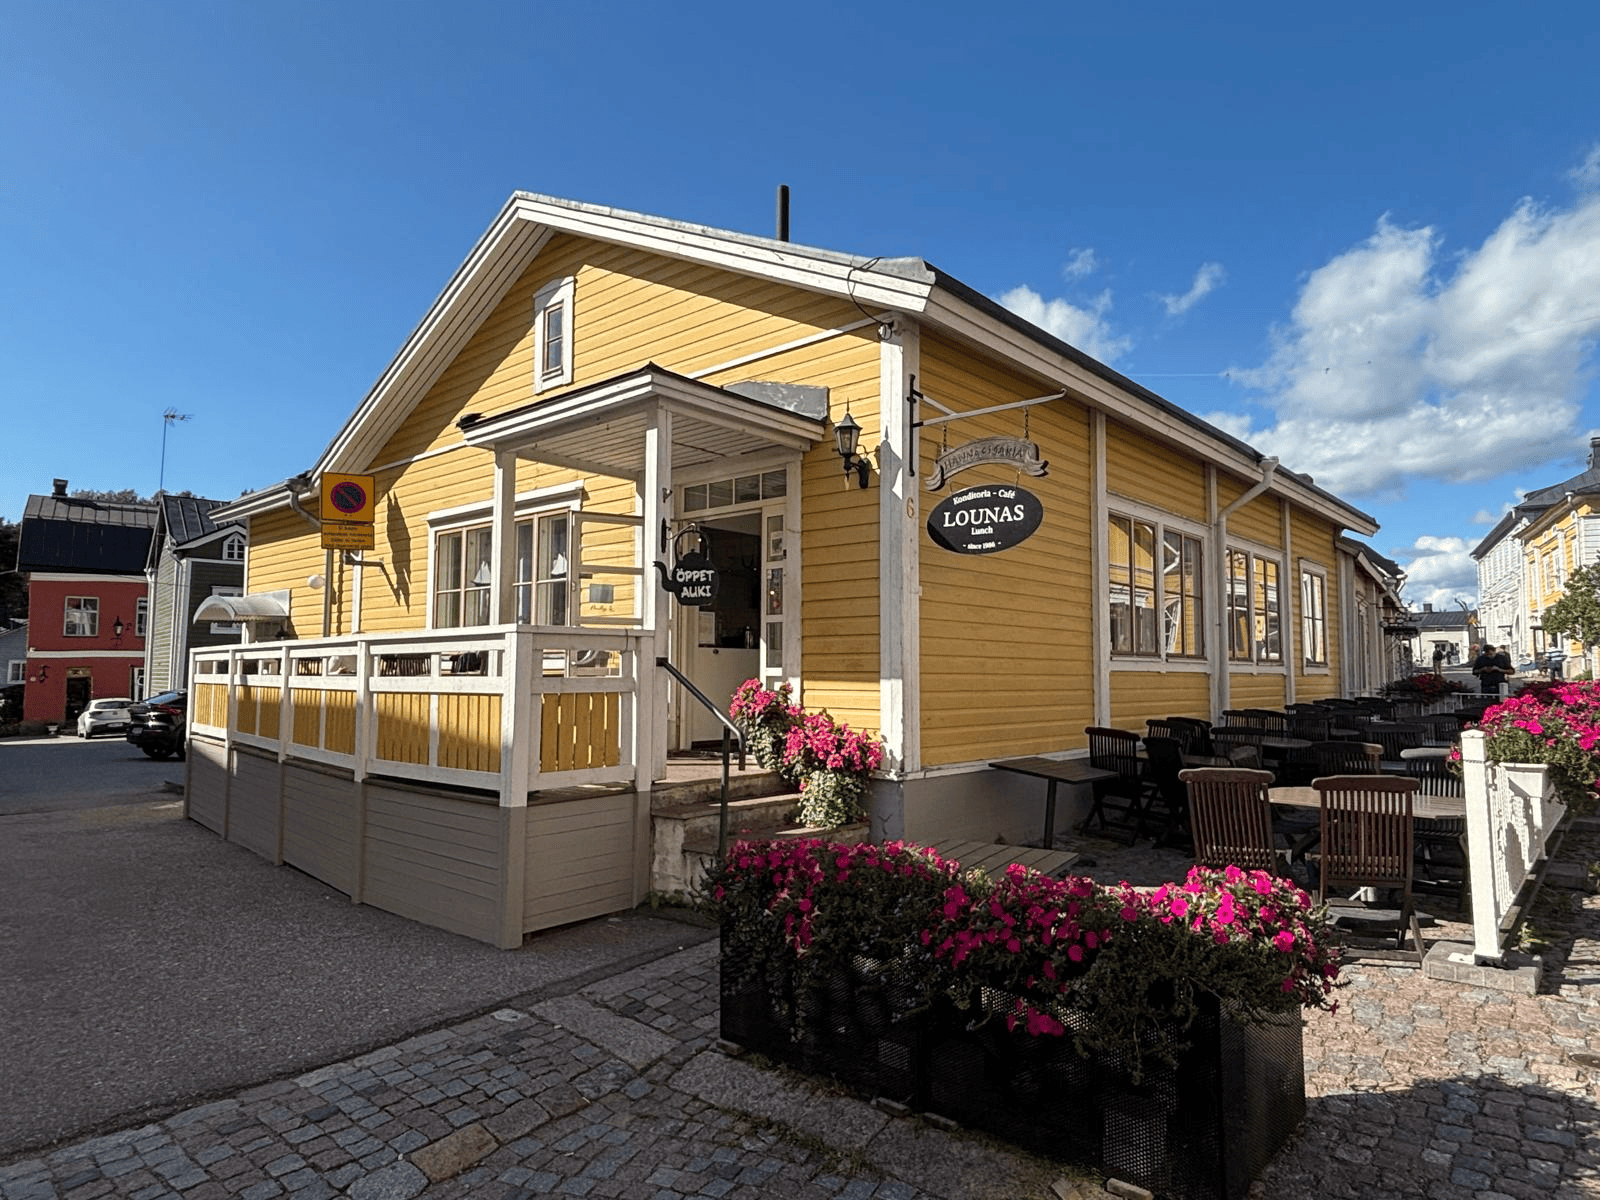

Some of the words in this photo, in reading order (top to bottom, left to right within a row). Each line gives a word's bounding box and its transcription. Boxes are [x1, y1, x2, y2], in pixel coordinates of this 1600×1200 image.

[953, 489, 991, 505] Konditoria
[998, 489, 1016, 499] Café
[943, 504, 1025, 528] LOUNAS
[971, 525, 993, 536] Lunch
[676, 568, 715, 582] ÖPPET
[681, 585, 712, 598] AUKI
